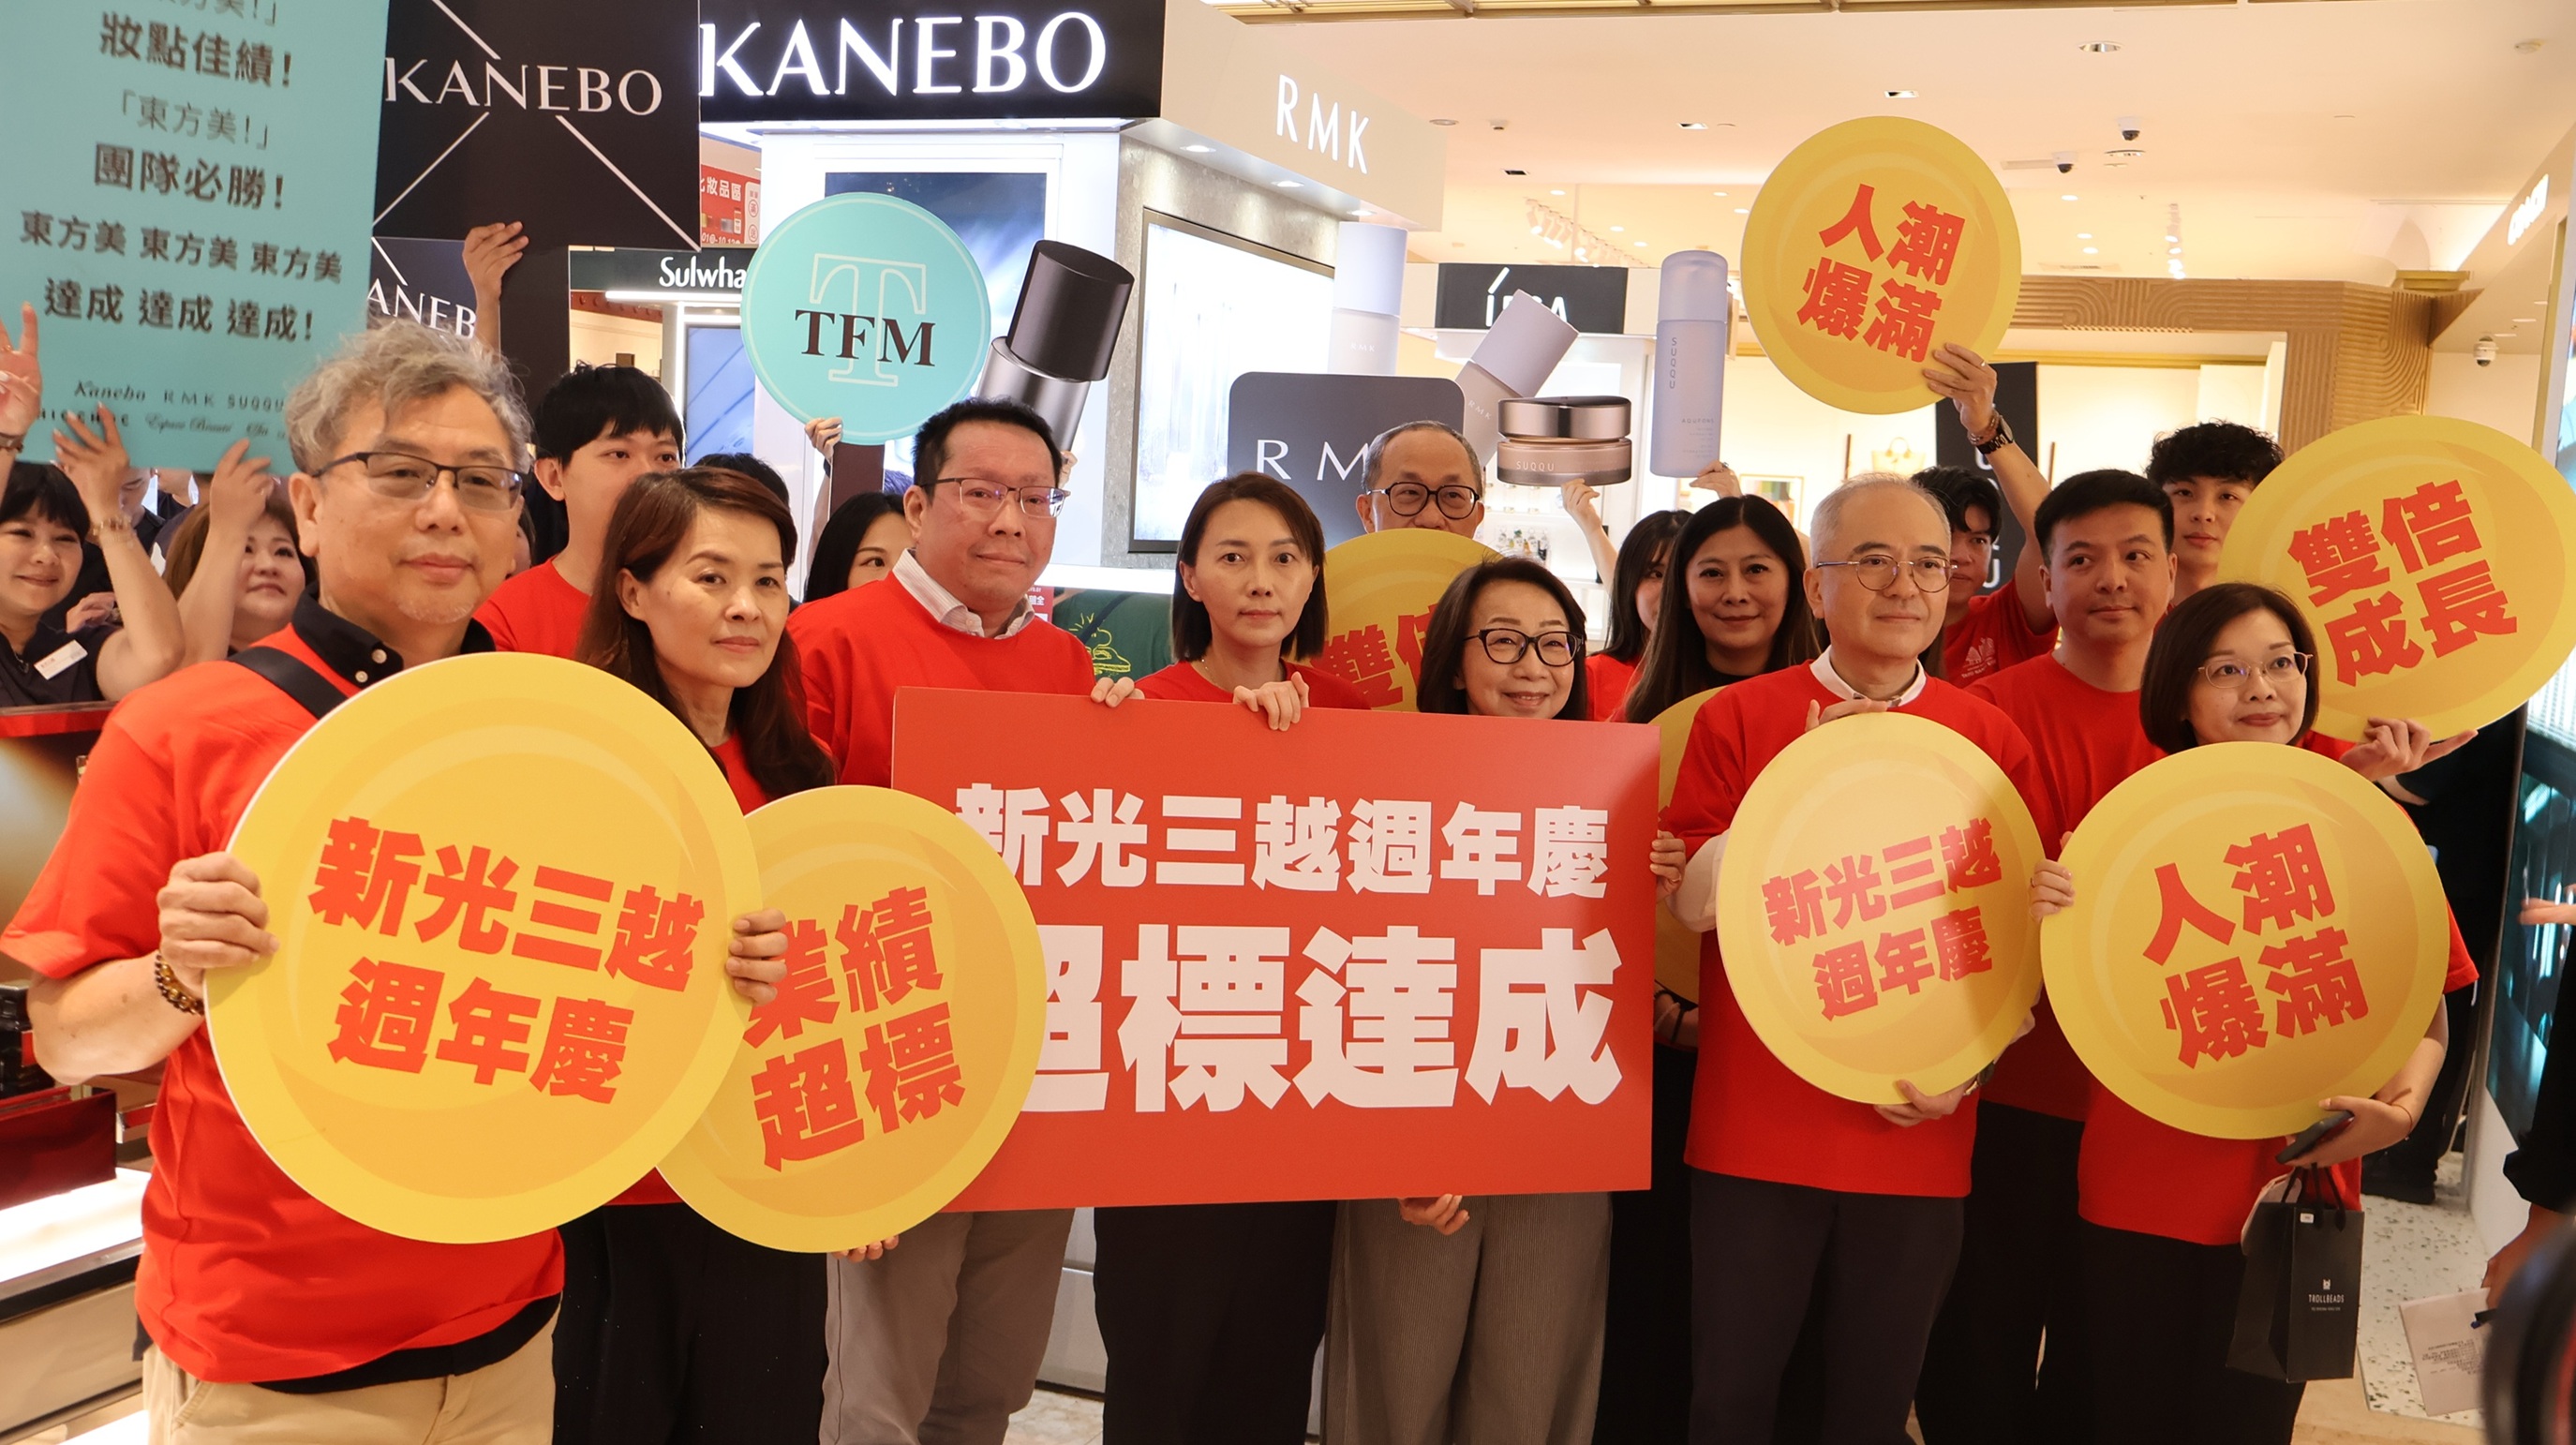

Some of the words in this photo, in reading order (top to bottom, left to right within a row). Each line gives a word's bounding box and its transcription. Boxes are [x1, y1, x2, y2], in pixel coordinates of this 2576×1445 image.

[384, 57, 663, 116] KANEBO
[698, 11, 1107, 97] KANEBO
[1276, 74, 1370, 175] RMK
[19, 210, 127, 256] 東方美
[139, 227, 239, 272] 東方美
[249, 242, 343, 281] 東方美
[1819, 184, 1966, 285] 人潮
[44, 277, 125, 322] 達成
[138, 289, 214, 332] 達成
[795, 309, 936, 367] TFM
[1796, 256, 1943, 363] 爆滿
[1515, 460, 1556, 472] SUQQU
[2286, 479, 2483, 608] 雙倍
[2324, 559, 2518, 687] 成長
[955, 782, 1609, 898] 新光三越週年慶
[1762, 817, 2003, 946] 新光三越
[2143, 823, 2335, 965] 人潮
[308, 816, 705, 992] 新光三越
[742, 886, 944, 1049] 業績
[1812, 905, 1994, 1021] 週年慶
[2159, 926, 2371, 1069] 爆滿
[327, 956, 636, 1105] 週年慶
[751, 1001, 966, 1172] 超標
